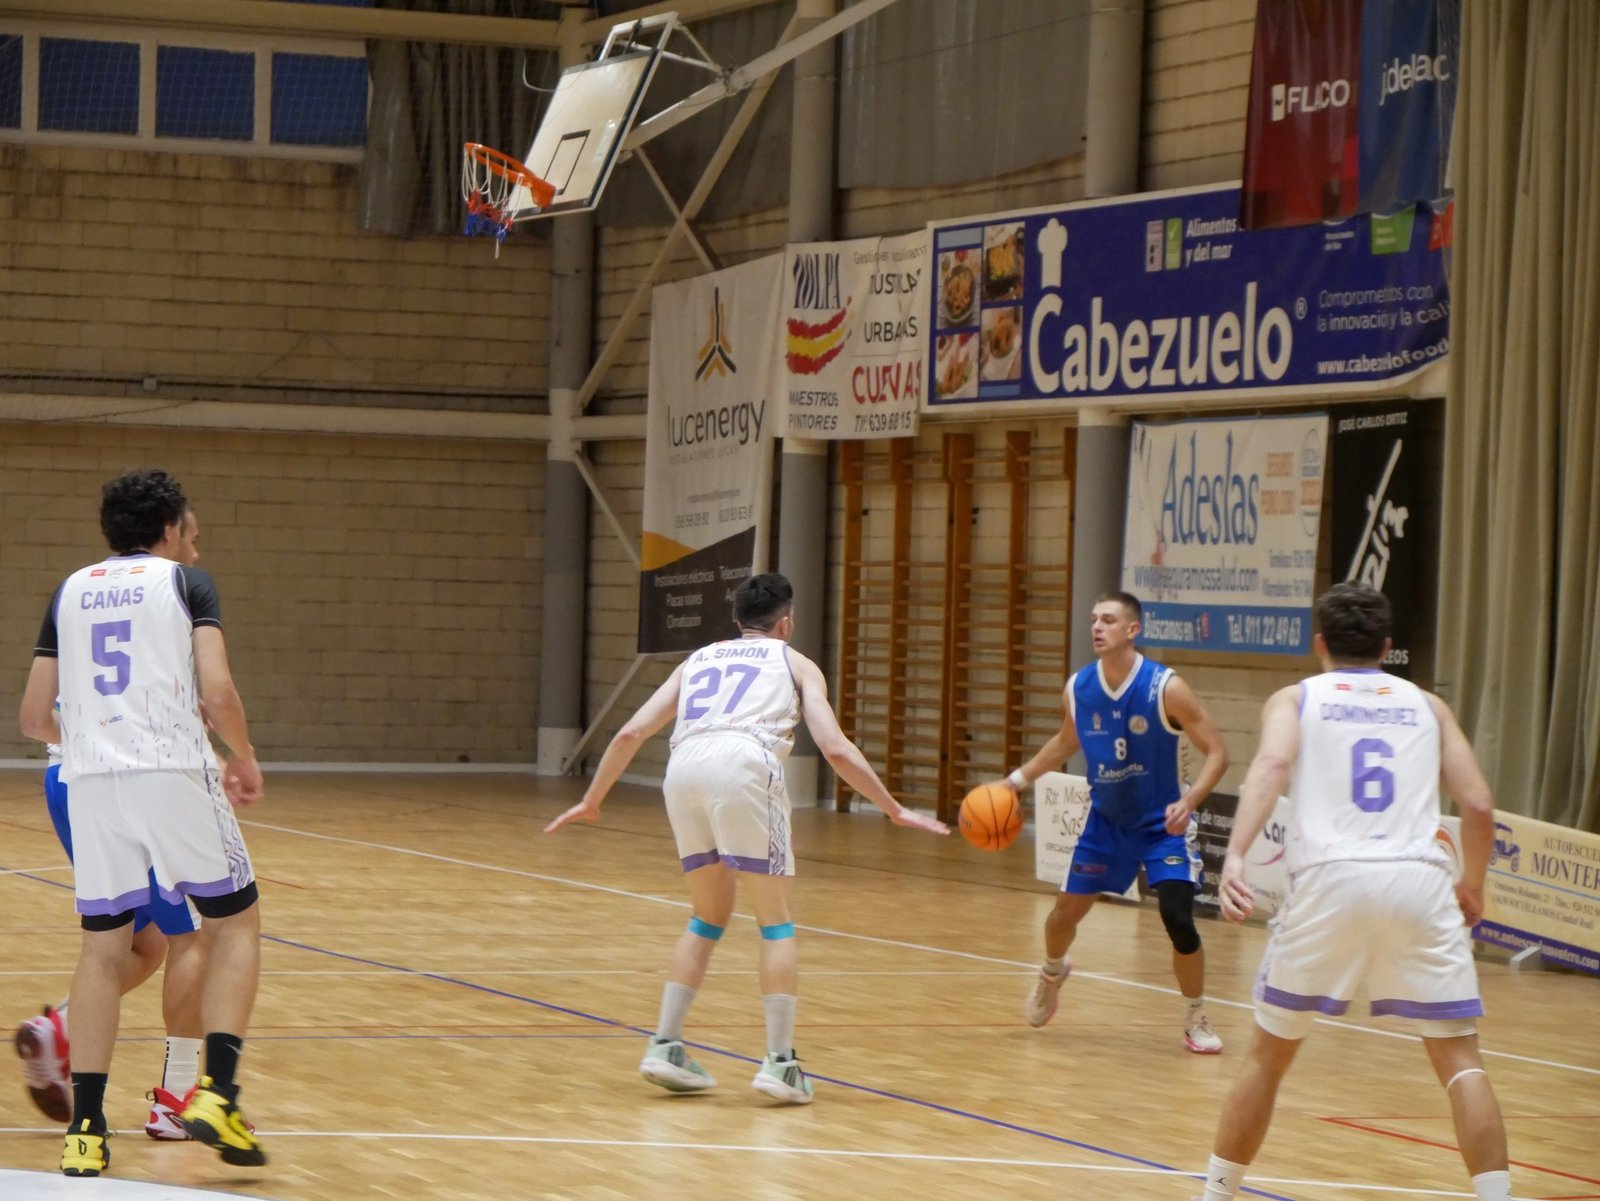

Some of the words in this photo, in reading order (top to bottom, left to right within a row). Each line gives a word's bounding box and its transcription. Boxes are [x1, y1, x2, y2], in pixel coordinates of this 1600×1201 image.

[1186, 217, 1237, 237] Alimentos
[1186, 249, 1192, 267] y
[1194, 243, 1210, 260] del
[1212, 244, 1233, 259] mar
[1400, 307, 1412, 326] la
[1030, 281, 1293, 395] Cabezuelo
[789, 390, 839, 407] MAESTROS
[668, 400, 765, 447] lucenergy
[789, 413, 838, 431] PINTORES
[1161, 428, 1259, 545] Adeslas
[81, 586, 144, 610] CAÑAS
[1227, 614, 1244, 644] Tel.
[91, 619, 131, 697] 5
[693, 652, 708, 664] A.
[684, 663, 762, 720] 27
[1115, 737, 1127, 761] 8
[1352, 738, 1395, 813] 6
